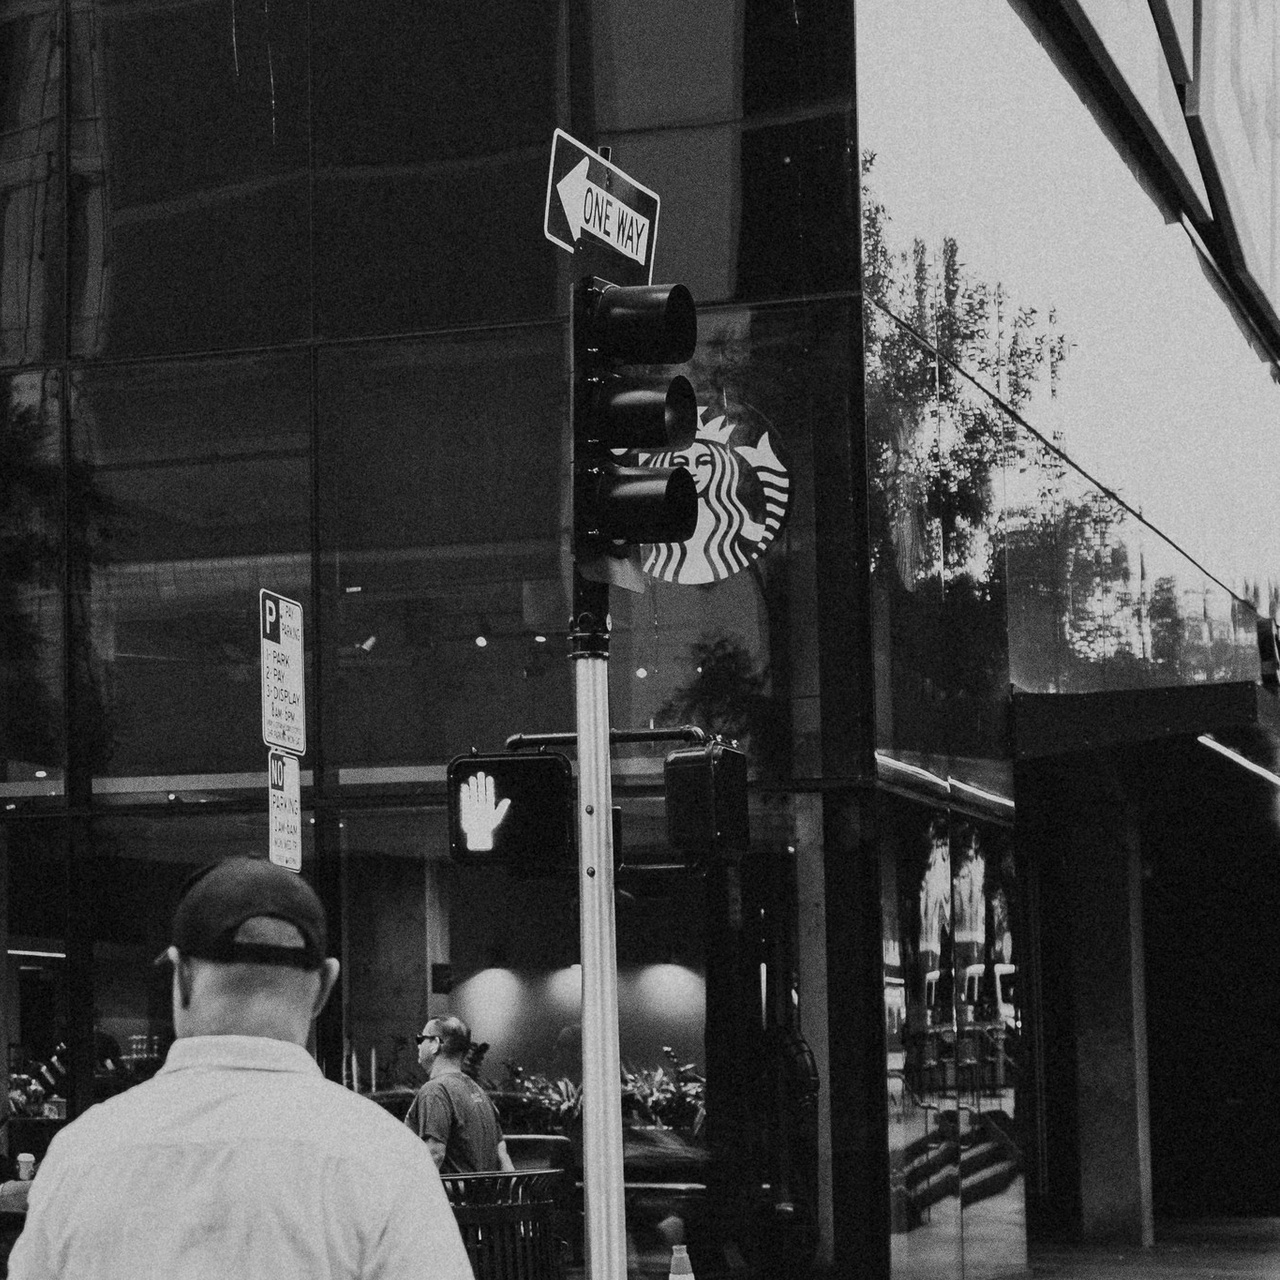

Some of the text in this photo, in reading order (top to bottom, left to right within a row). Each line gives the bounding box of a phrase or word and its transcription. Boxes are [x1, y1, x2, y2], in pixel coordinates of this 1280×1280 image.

[583, 186, 646, 256] ONE WAY
[265, 599, 276, 634] P
[271, 759, 283, 786] NO
[272, 793, 298, 816] PARKING
